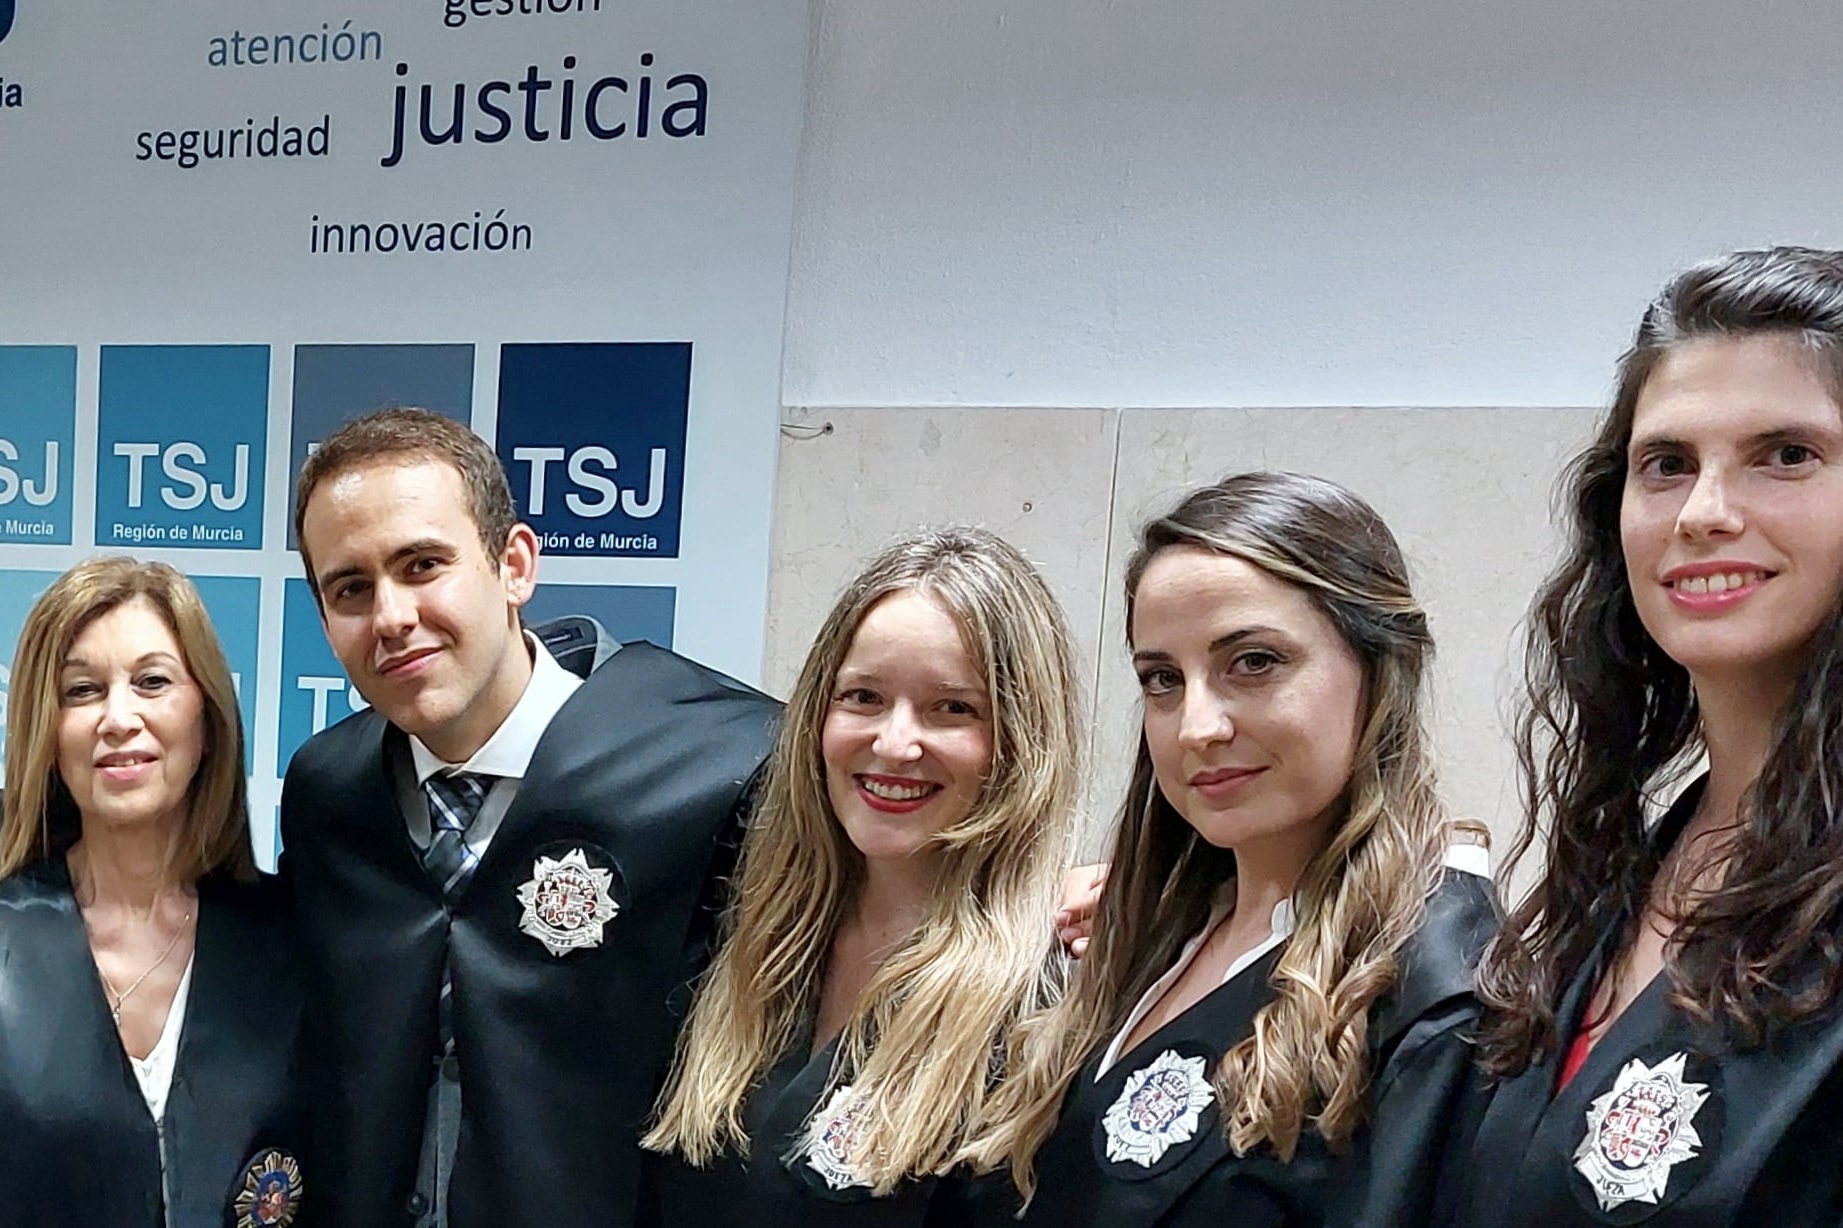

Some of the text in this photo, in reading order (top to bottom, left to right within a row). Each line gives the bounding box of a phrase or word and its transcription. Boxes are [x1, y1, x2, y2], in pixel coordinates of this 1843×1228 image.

[207, 20, 383, 66] atención
[380, 52, 709, 167] justicia
[135, 114, 331, 168] seguridad
[309, 209, 533, 254] innovación
[113, 442, 250, 511] TSJ
[513, 446, 666, 518] TSJ
[6, 519, 55, 536] Murcia
[113, 522, 244, 543] Región de Murcia
[537, 531, 658, 551] gión de Murcia
